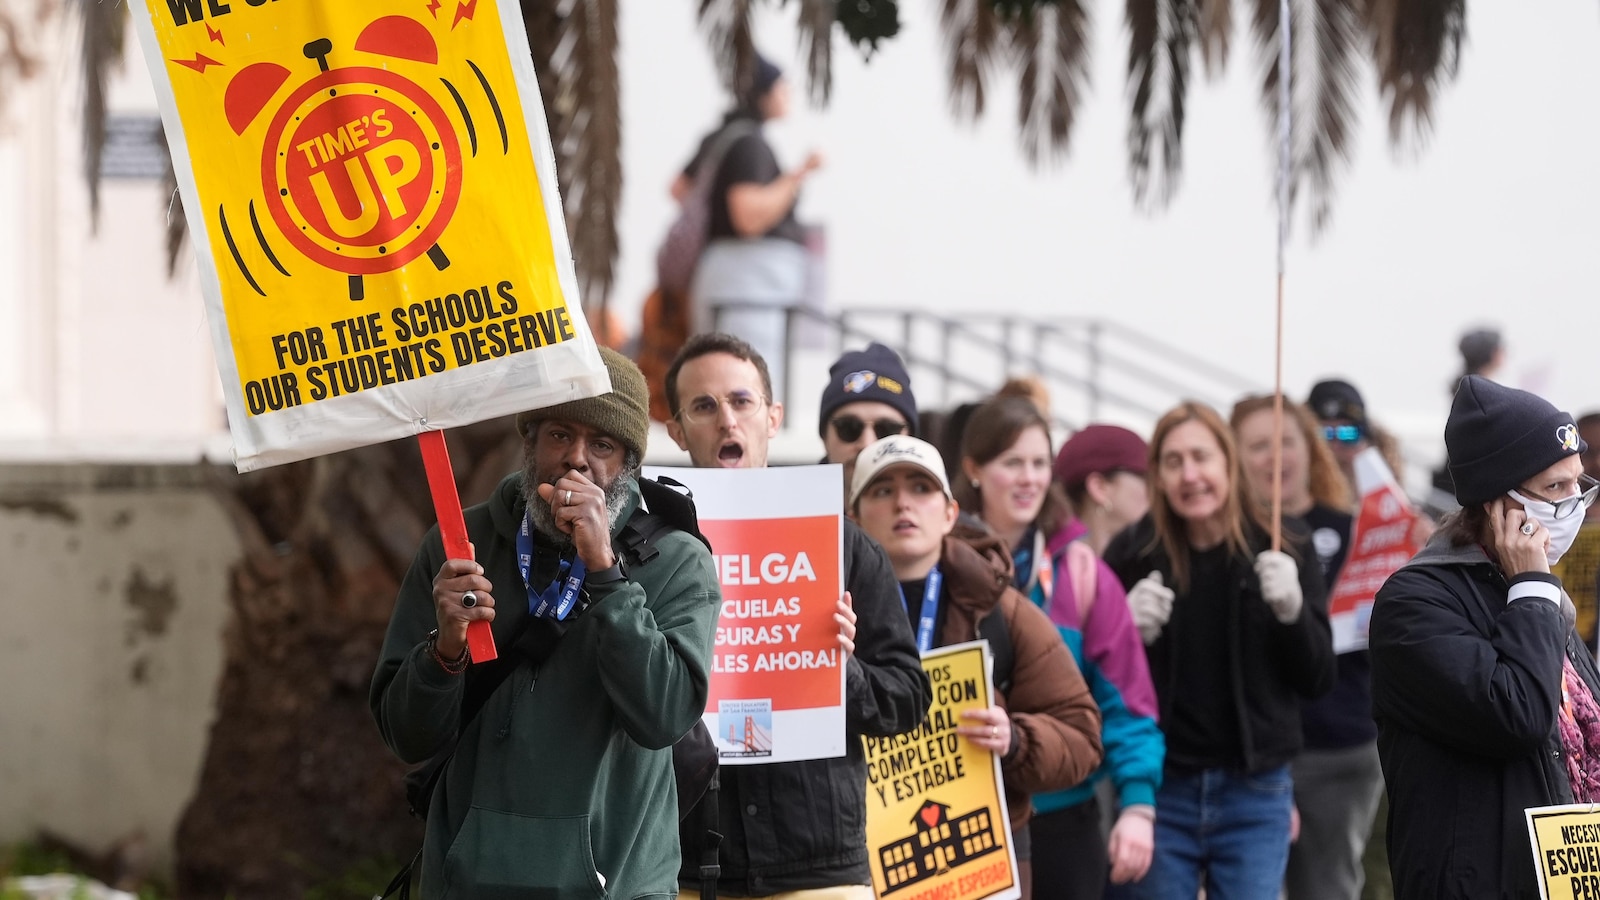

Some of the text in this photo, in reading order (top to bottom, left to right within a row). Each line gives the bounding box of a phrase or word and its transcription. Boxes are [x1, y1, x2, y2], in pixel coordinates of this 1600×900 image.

[296, 108, 394, 169] TIME'S
[308, 138, 422, 239] UP
[271, 280, 519, 370] FOR THE SCHOOLS
[245, 307, 575, 416] OUR STUDENTS DESERVE
[711, 551, 817, 586] ELGA
[719, 597, 801, 619] CUELAS
[714, 623, 802, 646] GURAS Y
[710, 648, 837, 673] LES AHORA!
[937, 679, 978, 707] CON
[867, 734, 959, 784] COMPLETO
[876, 756, 966, 808] Y ESTABLE
[957, 860, 1007, 896] ESPERAR
